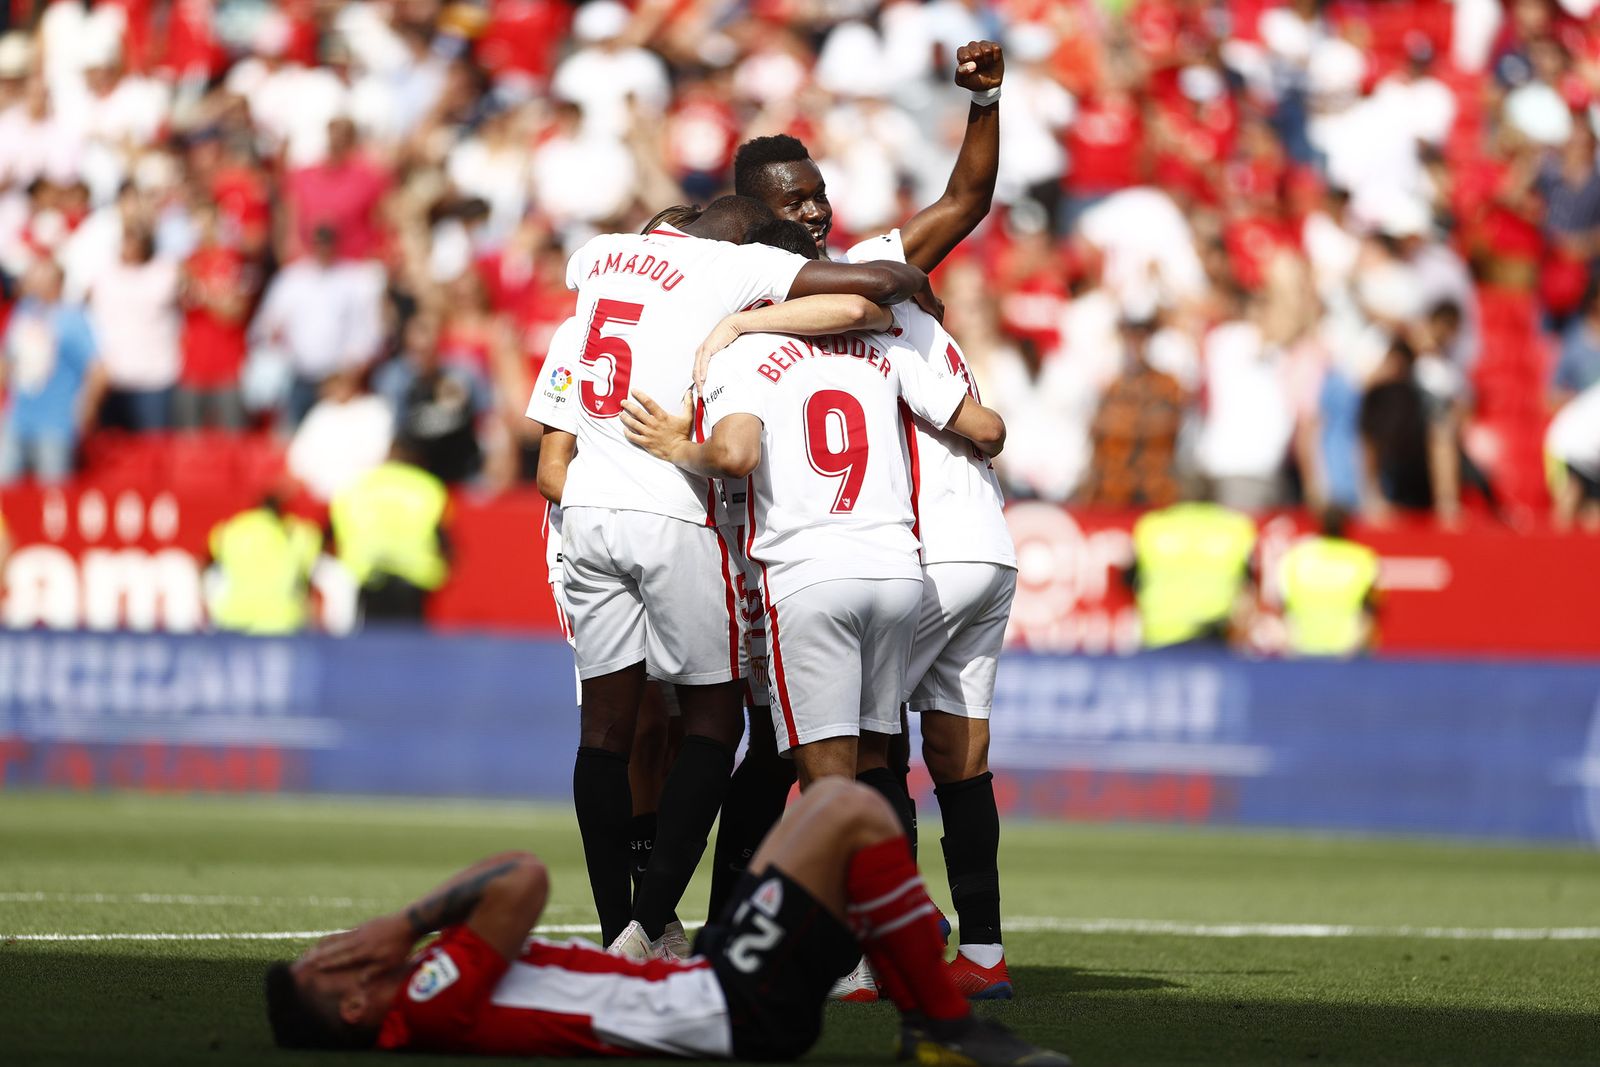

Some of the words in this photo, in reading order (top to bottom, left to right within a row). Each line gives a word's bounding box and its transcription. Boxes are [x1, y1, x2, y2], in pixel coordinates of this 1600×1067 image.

[588, 252, 685, 292] AMADOU
[578, 298, 645, 419] 5
[543, 389, 567, 404] LaLiga
[704, 385, 725, 404] tfair
[803, 389, 869, 514] 9
[630, 840, 653, 851] SFC
